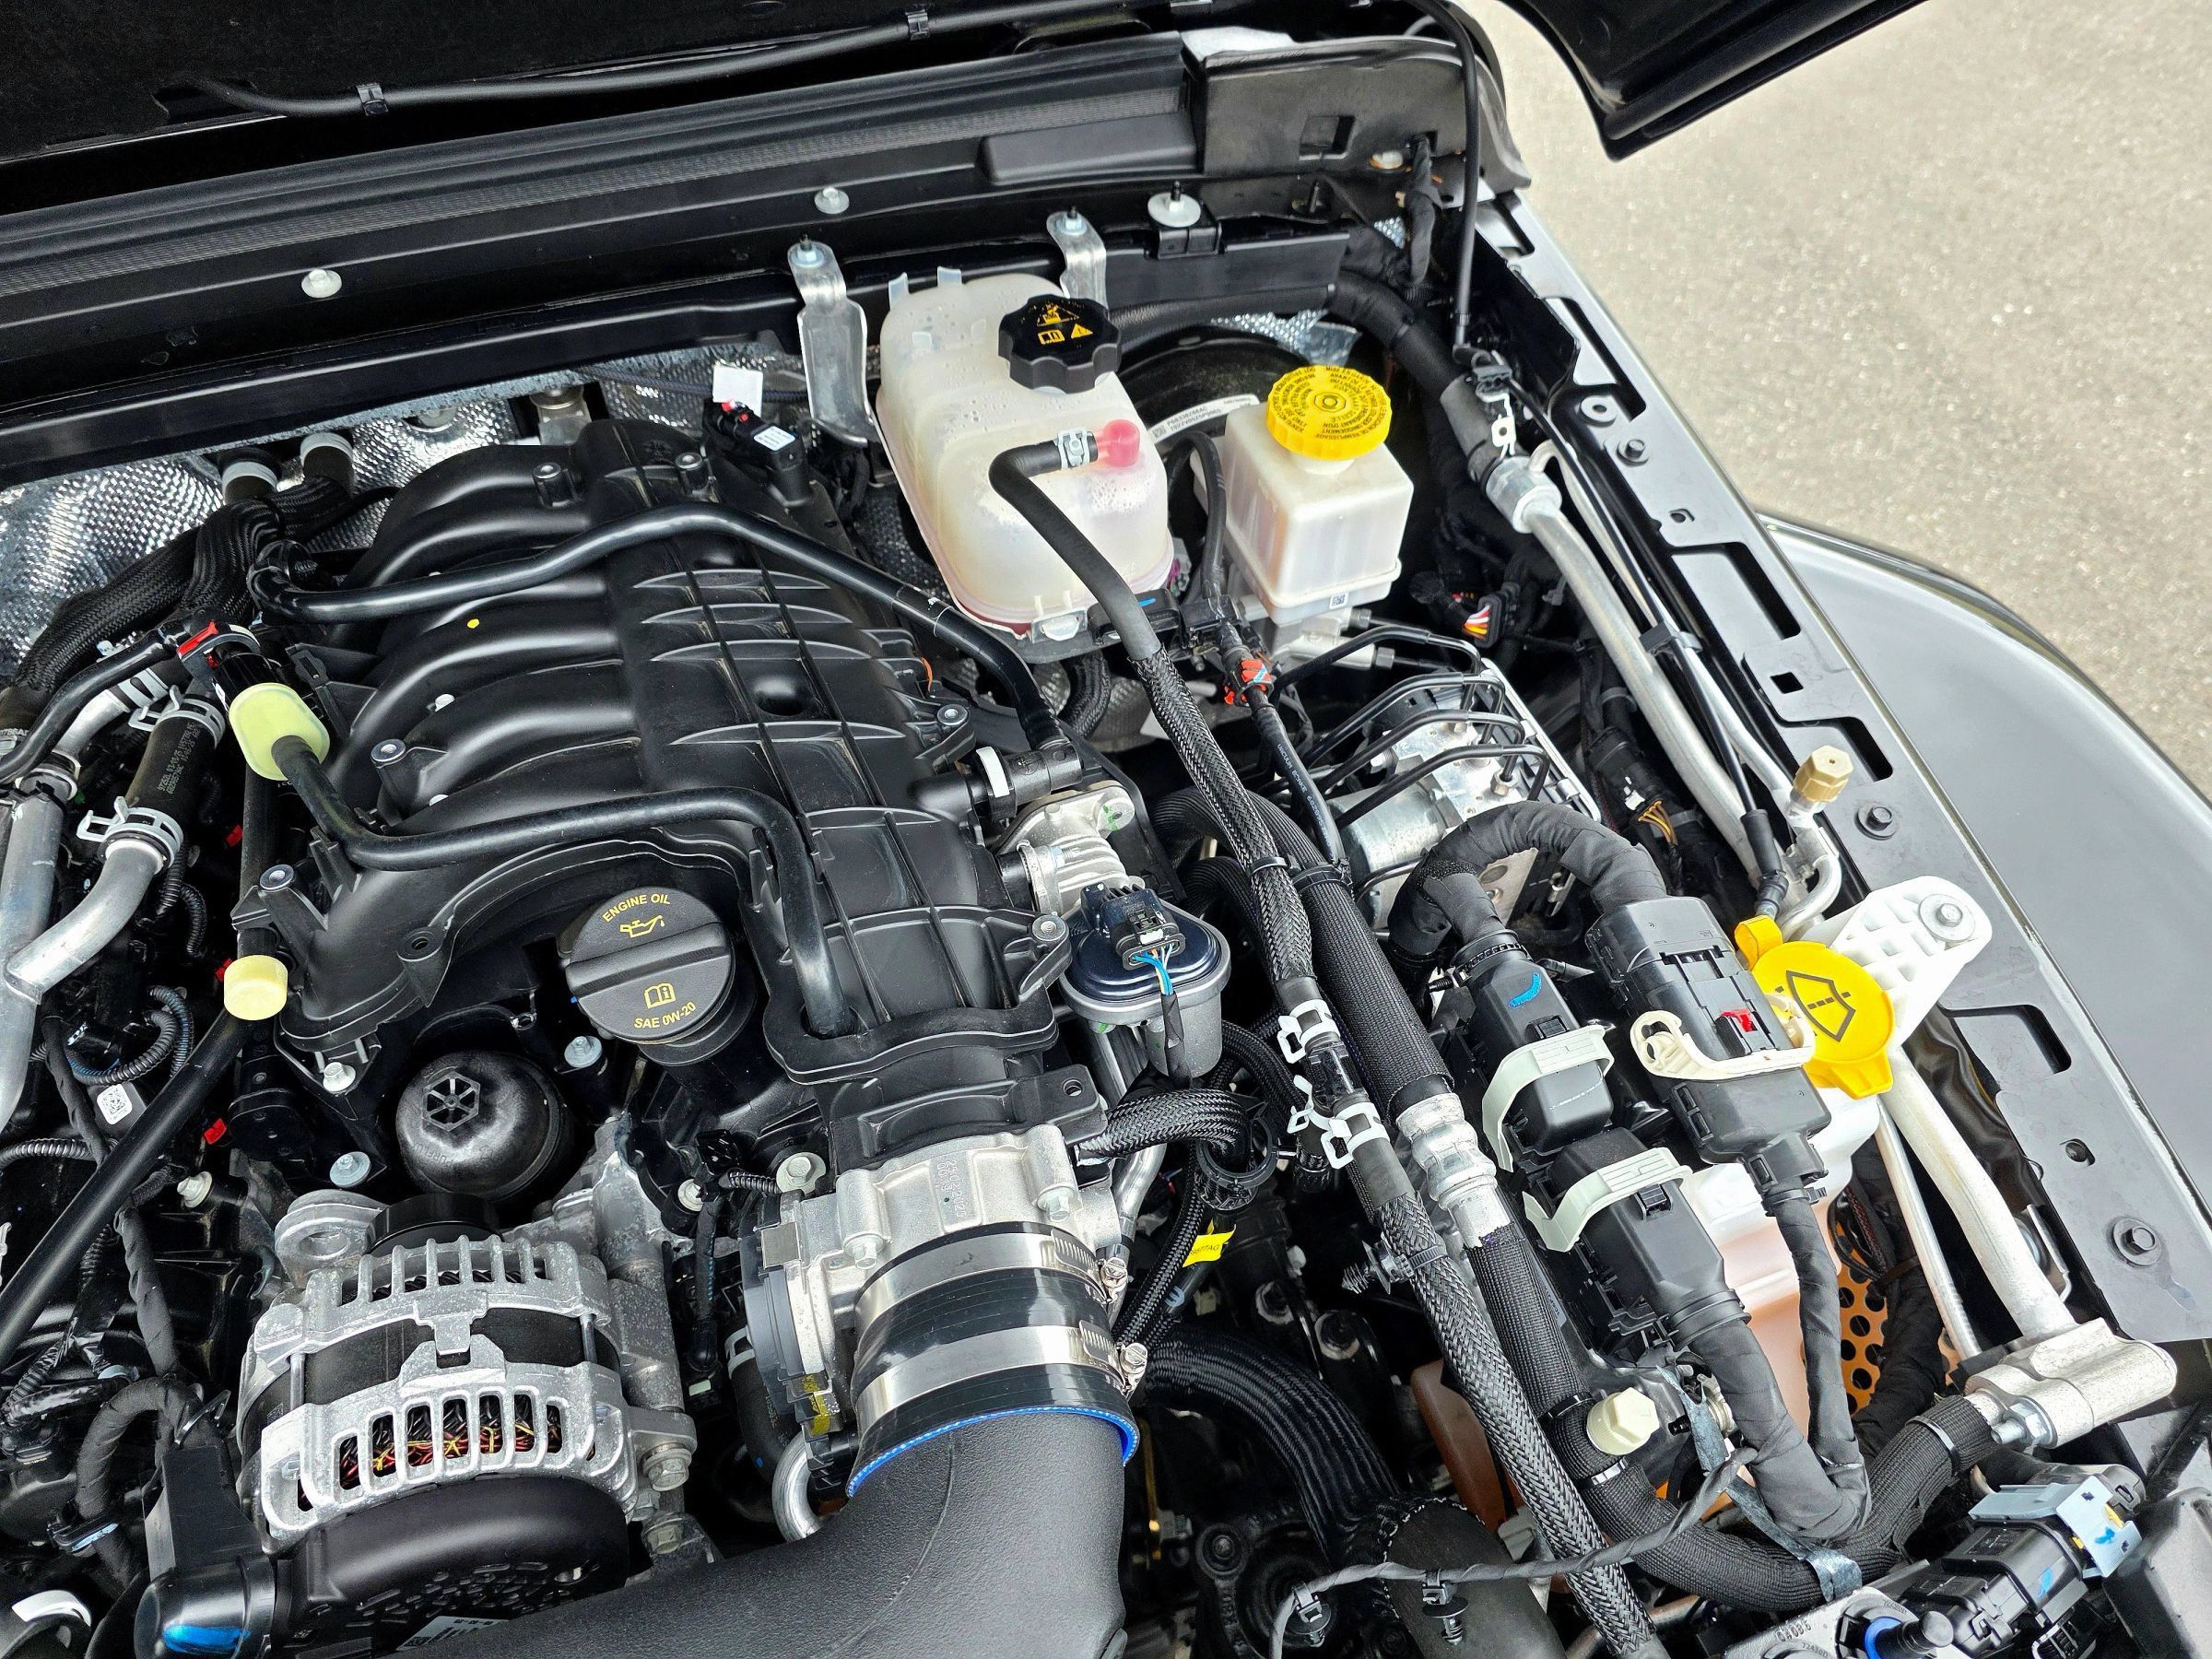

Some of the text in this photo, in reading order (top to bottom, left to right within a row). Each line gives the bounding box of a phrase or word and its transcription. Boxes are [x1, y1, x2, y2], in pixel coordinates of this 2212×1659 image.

[1277, 744, 1292, 769] VACUUM
[602, 893, 671, 924] ENGINE OIL
[634, 1001, 697, 1029] SAE 0W-20
